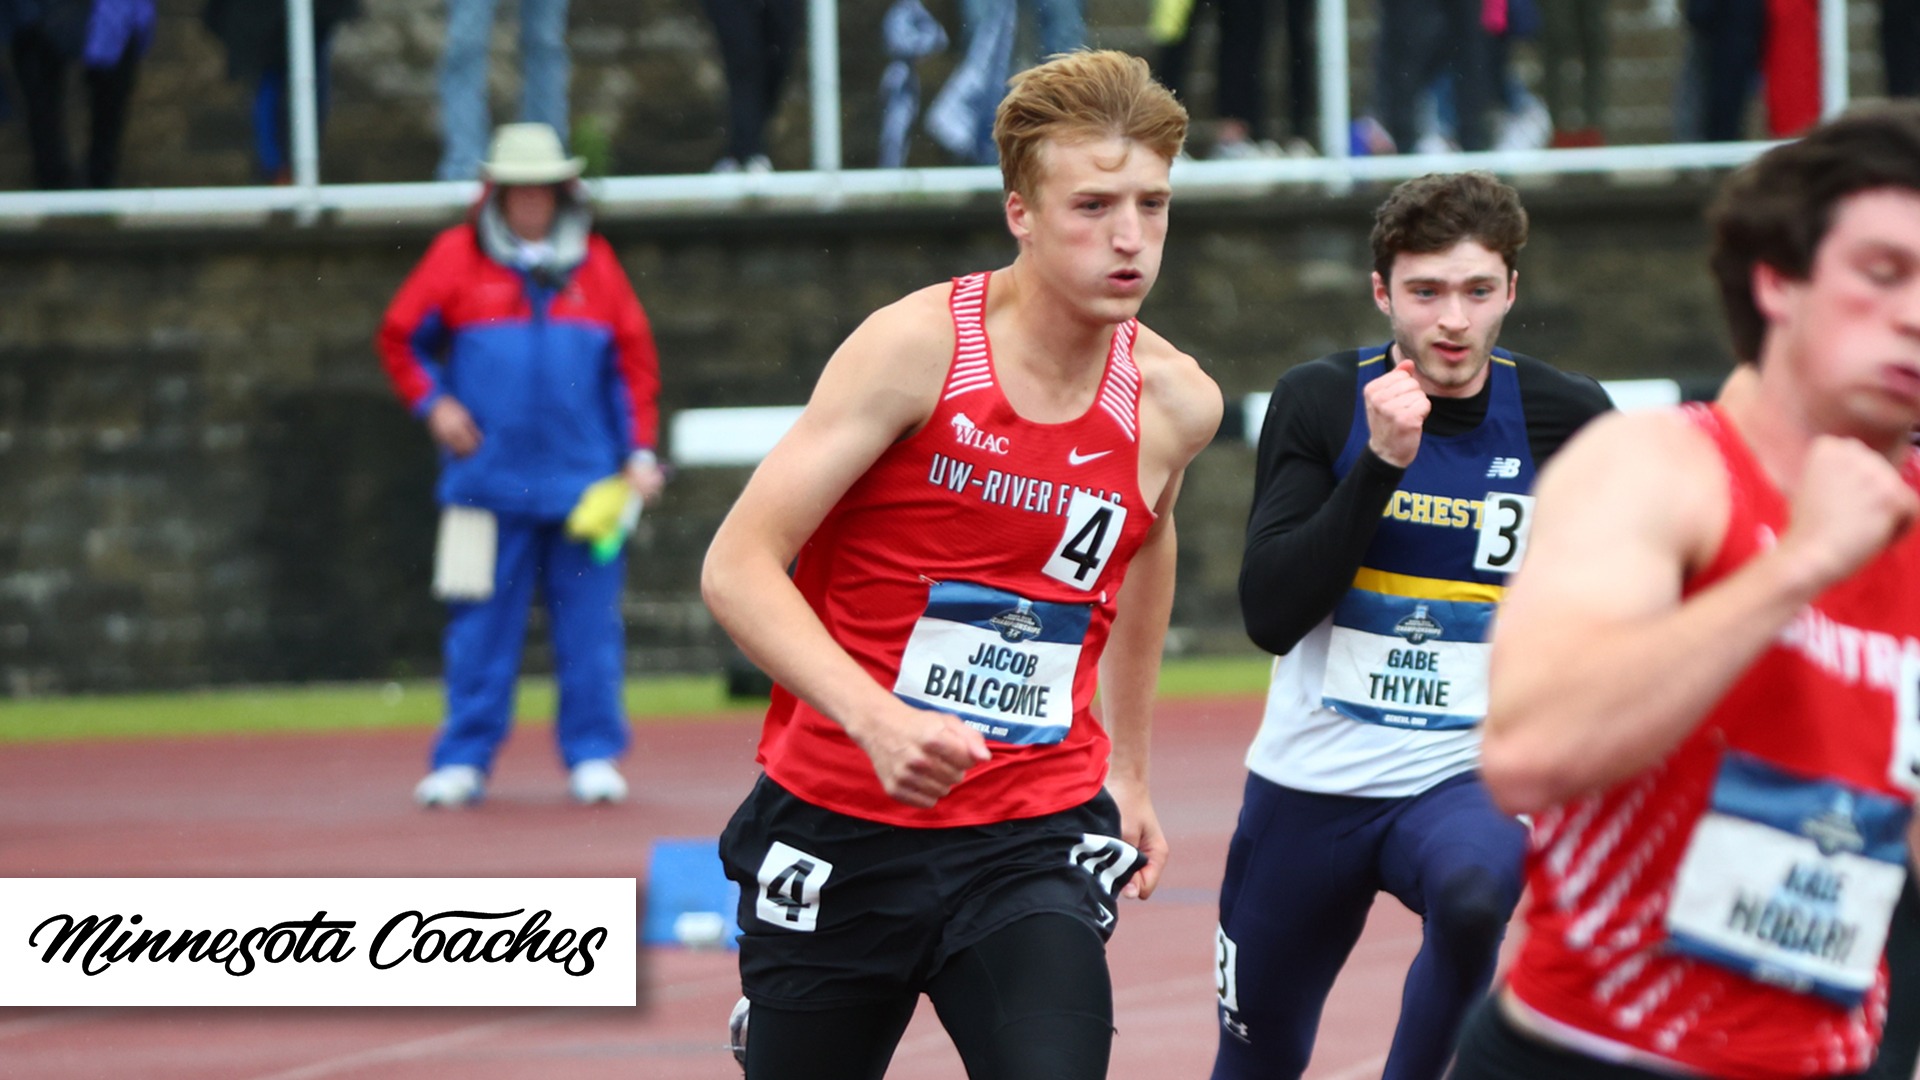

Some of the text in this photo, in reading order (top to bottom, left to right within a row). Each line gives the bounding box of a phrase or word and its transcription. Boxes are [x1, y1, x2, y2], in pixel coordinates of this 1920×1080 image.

[952, 423, 1010, 455] WIAC
[928, 452, 1053, 514] UW-RIVER
[1383, 489, 1486, 529] CHEST
[1487, 498, 1524, 567] 3
[1060, 505, 1115, 582] 4
[968, 642, 1039, 678] JACOB
[1387, 648, 1439, 672] GABE
[924, 663, 1051, 718] BALCOME
[1369, 673, 1451, 707] THYNE
[766, 858, 815, 922] 4
